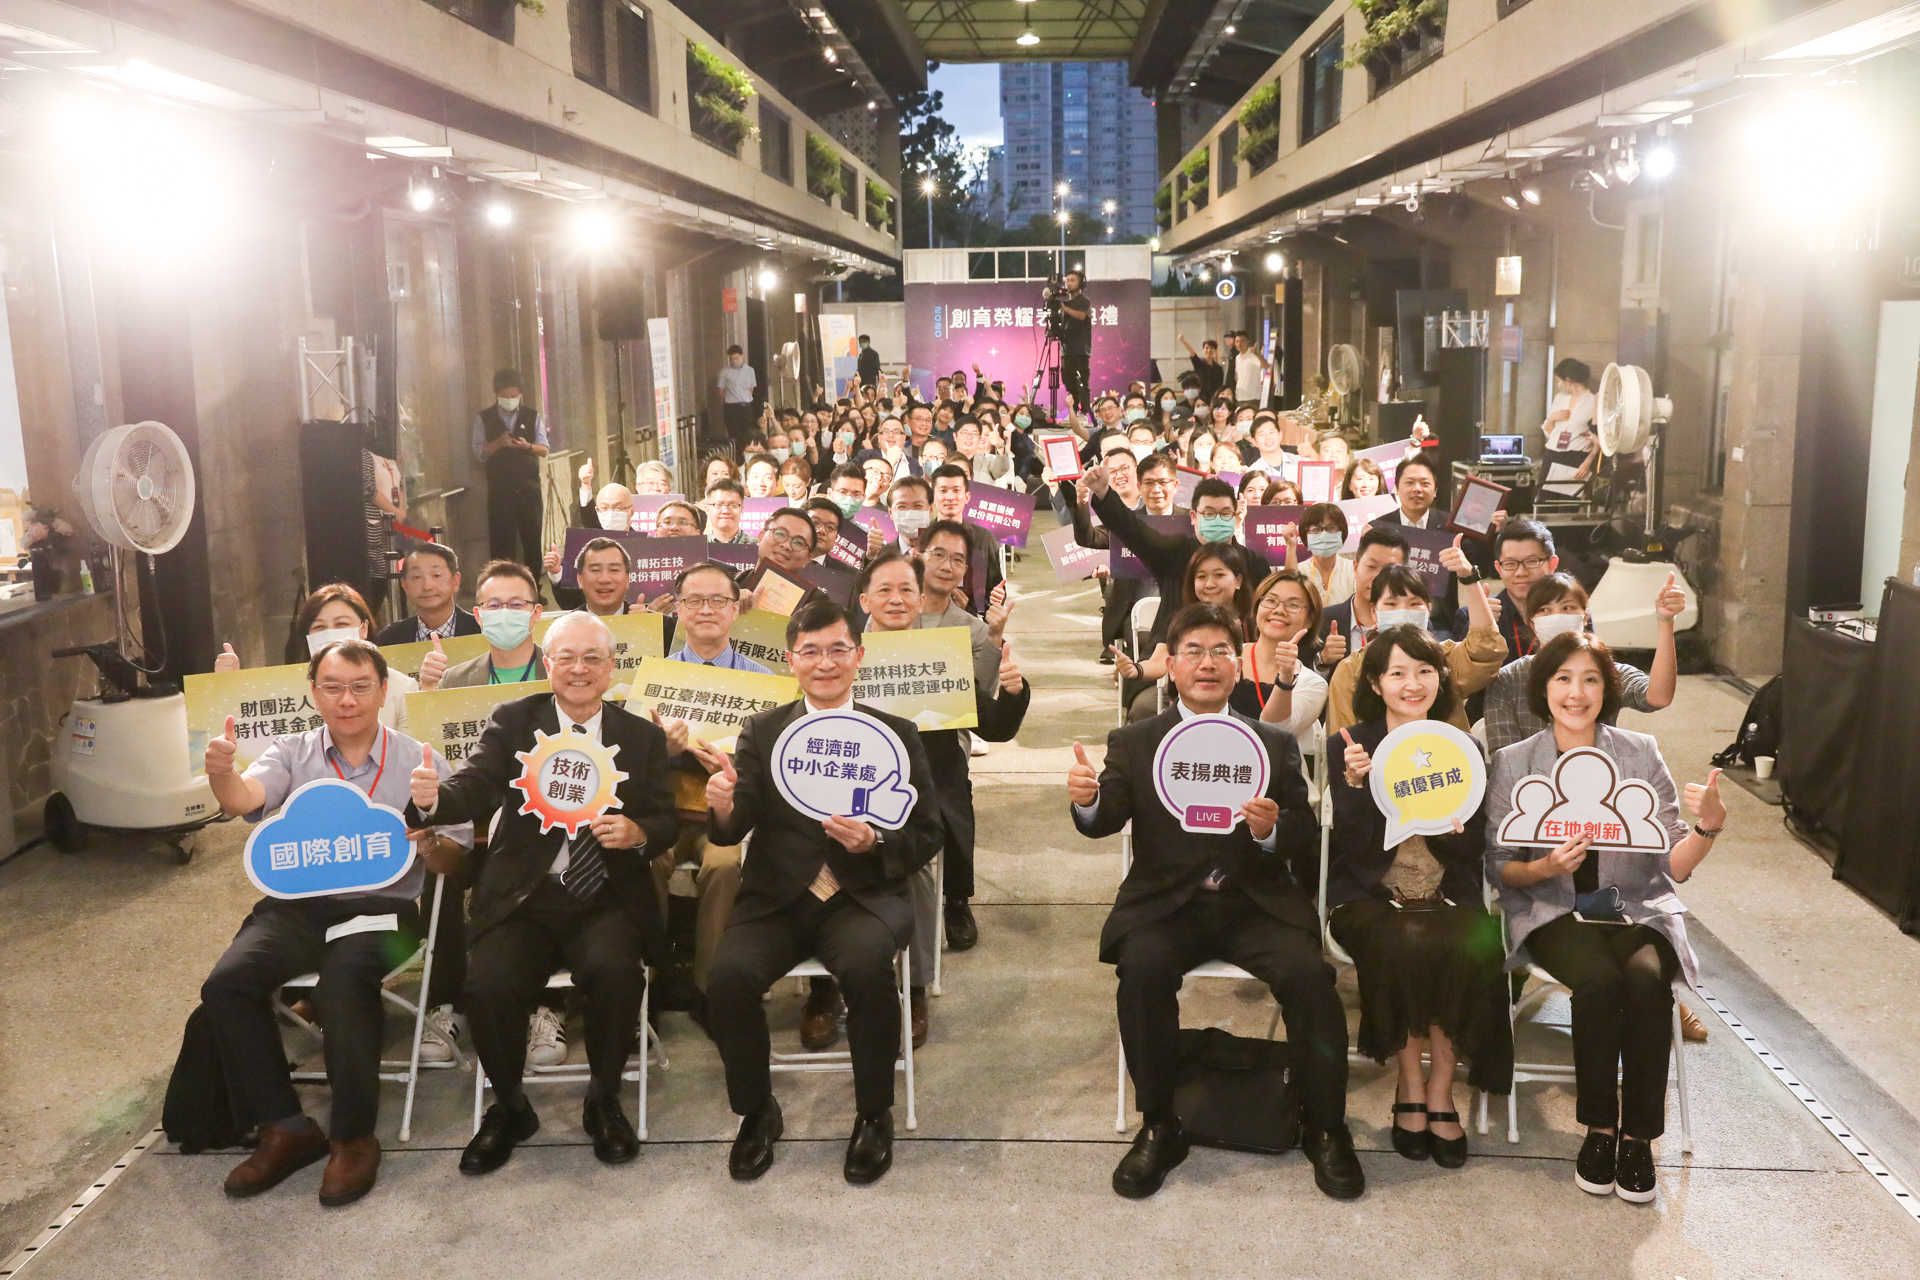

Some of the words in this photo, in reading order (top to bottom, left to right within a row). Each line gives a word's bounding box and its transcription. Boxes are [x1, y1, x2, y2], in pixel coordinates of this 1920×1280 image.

[949, 304, 1118, 329] 創育榮耀表禮
[637, 556, 684, 570] 精拓生技
[729, 637, 789, 663] 有限公司
[854, 661, 947, 681] 雲林科技大學
[644, 683, 779, 713] 國立臺灣科技大學
[852, 677, 970, 699] 智財育成營運中心
[240, 697, 316, 719] 財團法人
[441, 719, 487, 740] 豪覓
[806, 737, 861, 759] 經濟部
[552, 757, 591, 780] 技術
[787, 757, 877, 783] 中小企業處
[1170, 761, 1252, 785] 表揚典禮
[547, 780, 586, 804] 創業
[1393, 767, 1464, 799] 績優育成
[1196, 811, 1222, 823] LIVE
[1544, 819, 1622, 841] 在地創新
[269, 831, 393, 871] 國際創育
